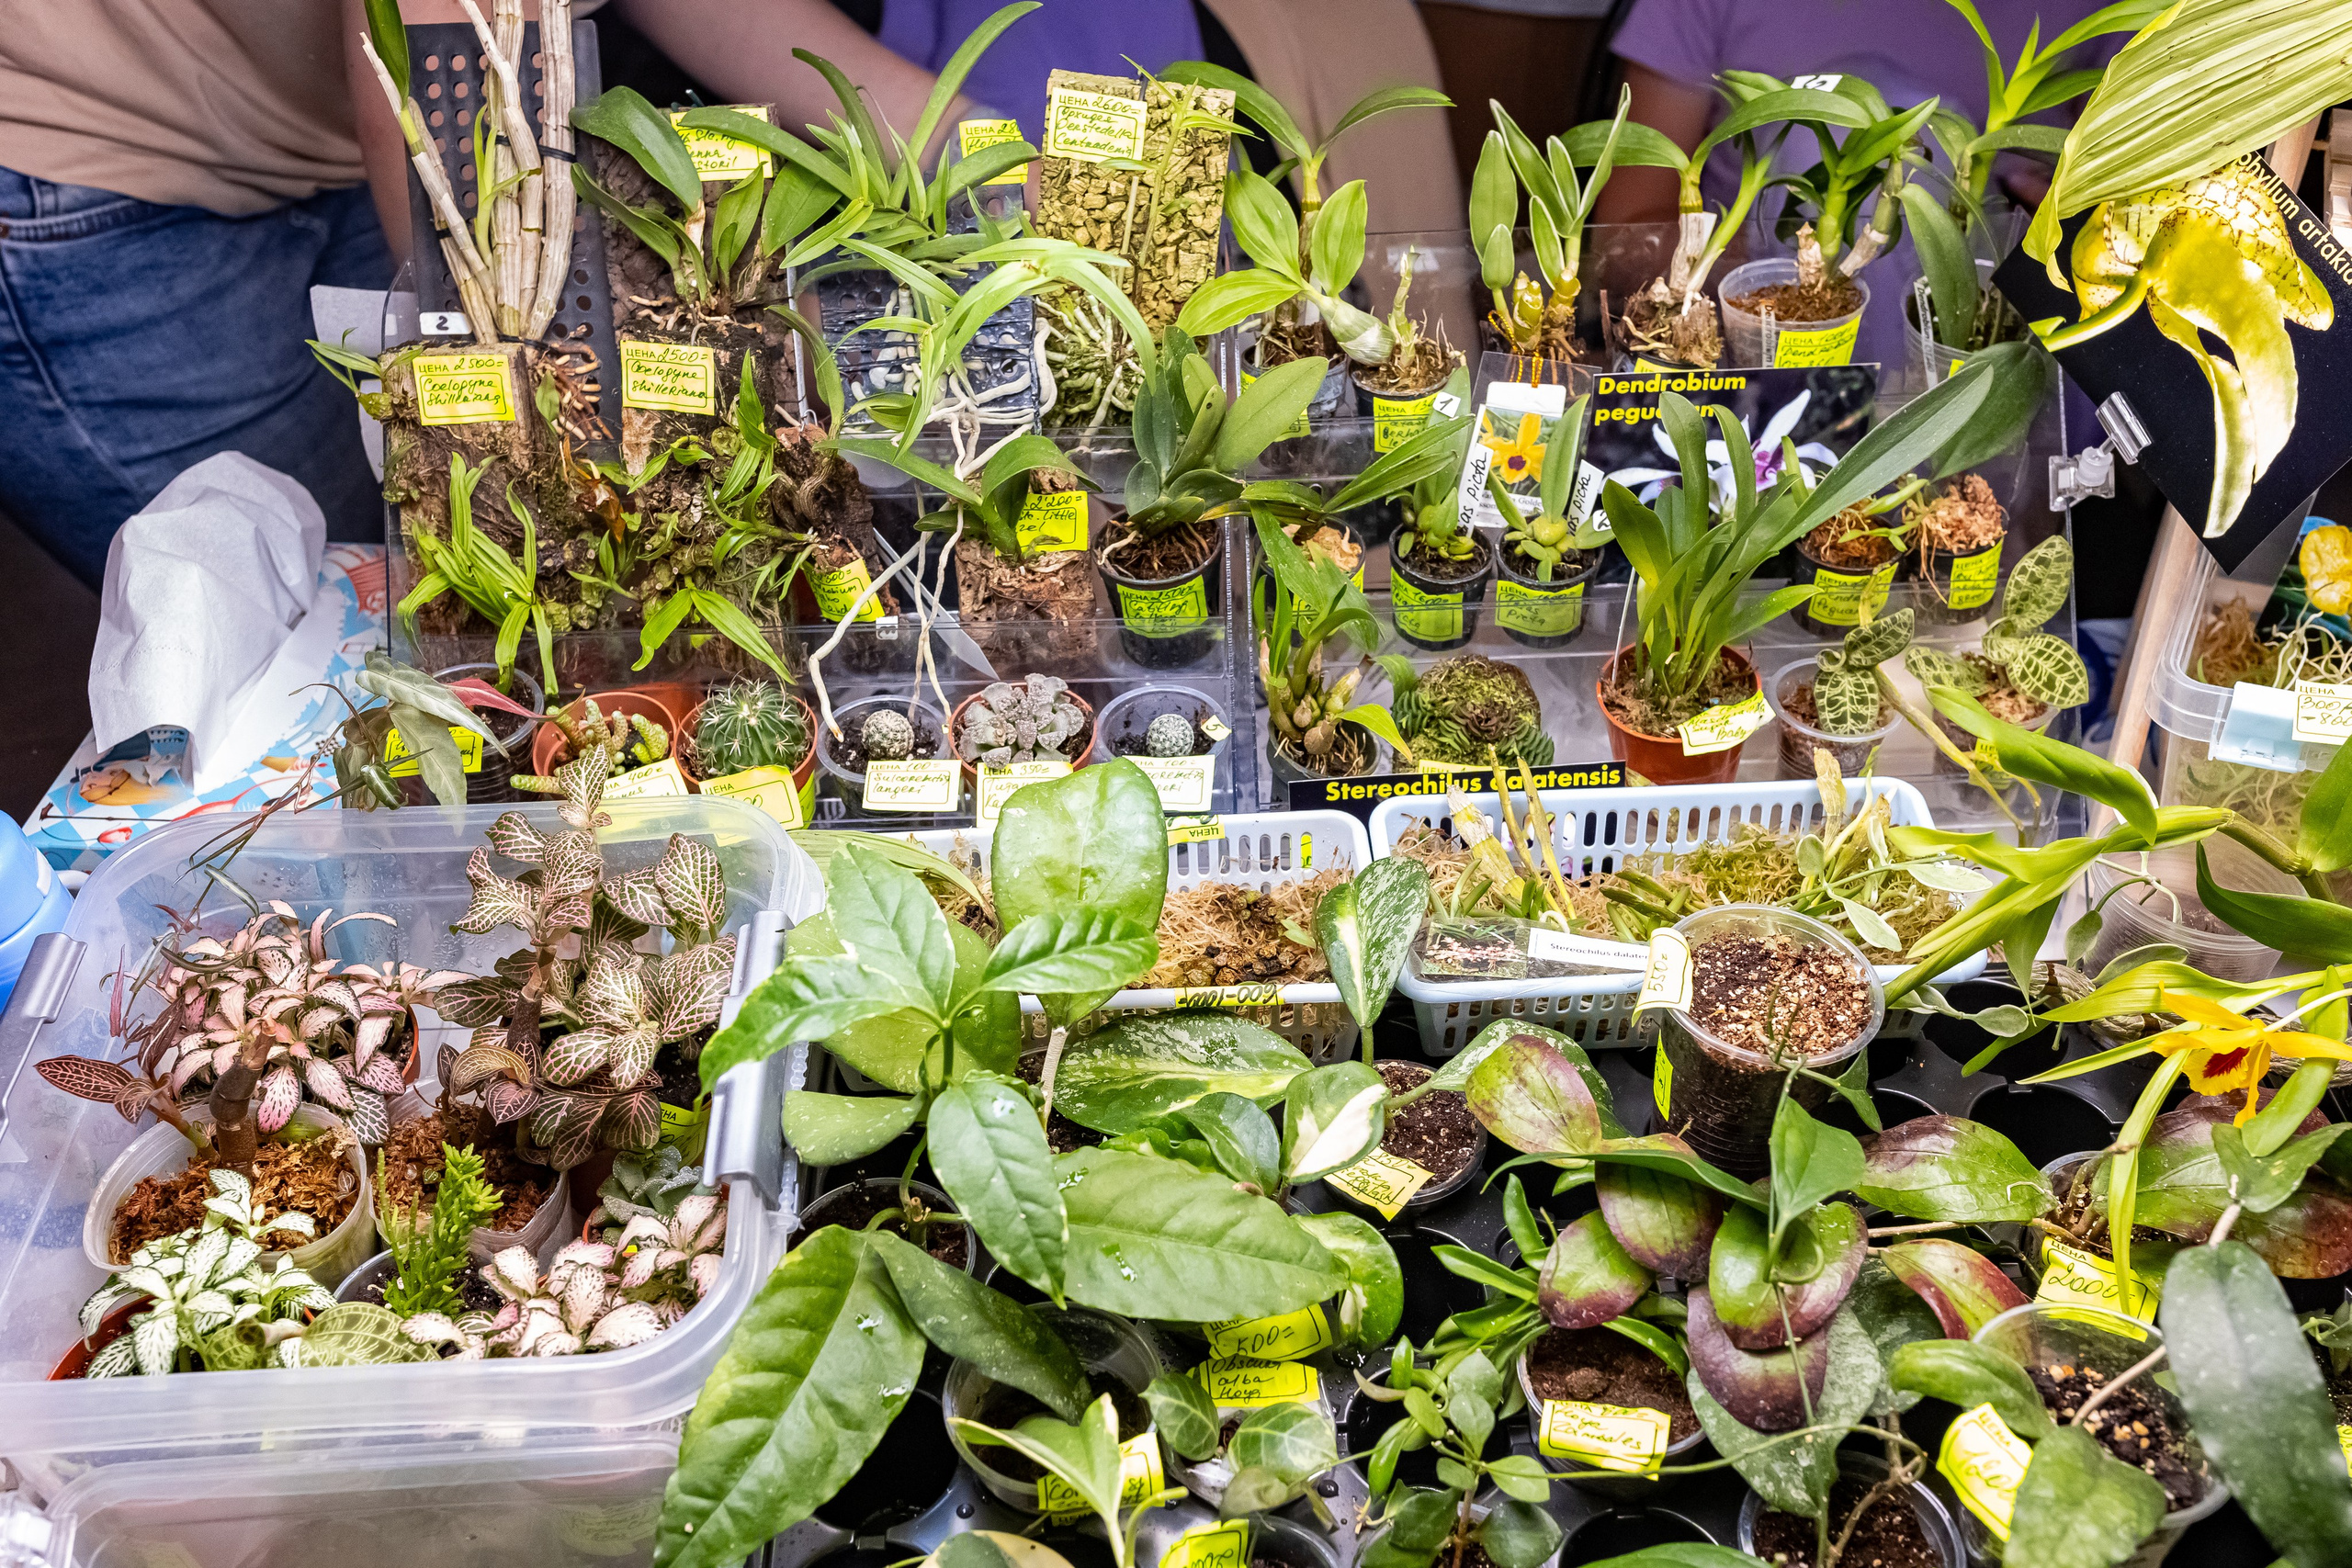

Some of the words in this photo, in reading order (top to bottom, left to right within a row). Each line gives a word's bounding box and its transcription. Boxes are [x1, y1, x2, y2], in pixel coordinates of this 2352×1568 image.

[1059, 95, 1089, 107] ЦЕНА
[966, 126, 995, 136] ЦЕНА
[436, 315, 449, 331] 2
[1784, 336, 1814, 345] ЦЕНА
[626, 348, 656, 359] ЦЕНА
[419, 365, 449, 374] ЦЕНА
[1598, 372, 1747, 396] Dendrobium
[1378, 404, 1407, 414] ЦЕНА
[1500, 586, 1528, 598] ЦЕНА
[2300, 685, 2335, 695] ЦЕНА
[984, 767, 1013, 776] ЦЕНА
[1325, 773, 1482, 802] Stereochilus
[1489, 764, 1621, 792] daatensis
[704, 783, 735, 796] ЦЕНА
[1189, 827, 1220, 838] ЦЕНА
[1550, 942, 1611, 957] Stereochilus
[2051, 1240, 2087, 1261] ЦЕНА
[1237, 1325, 1295, 1356] 500=
